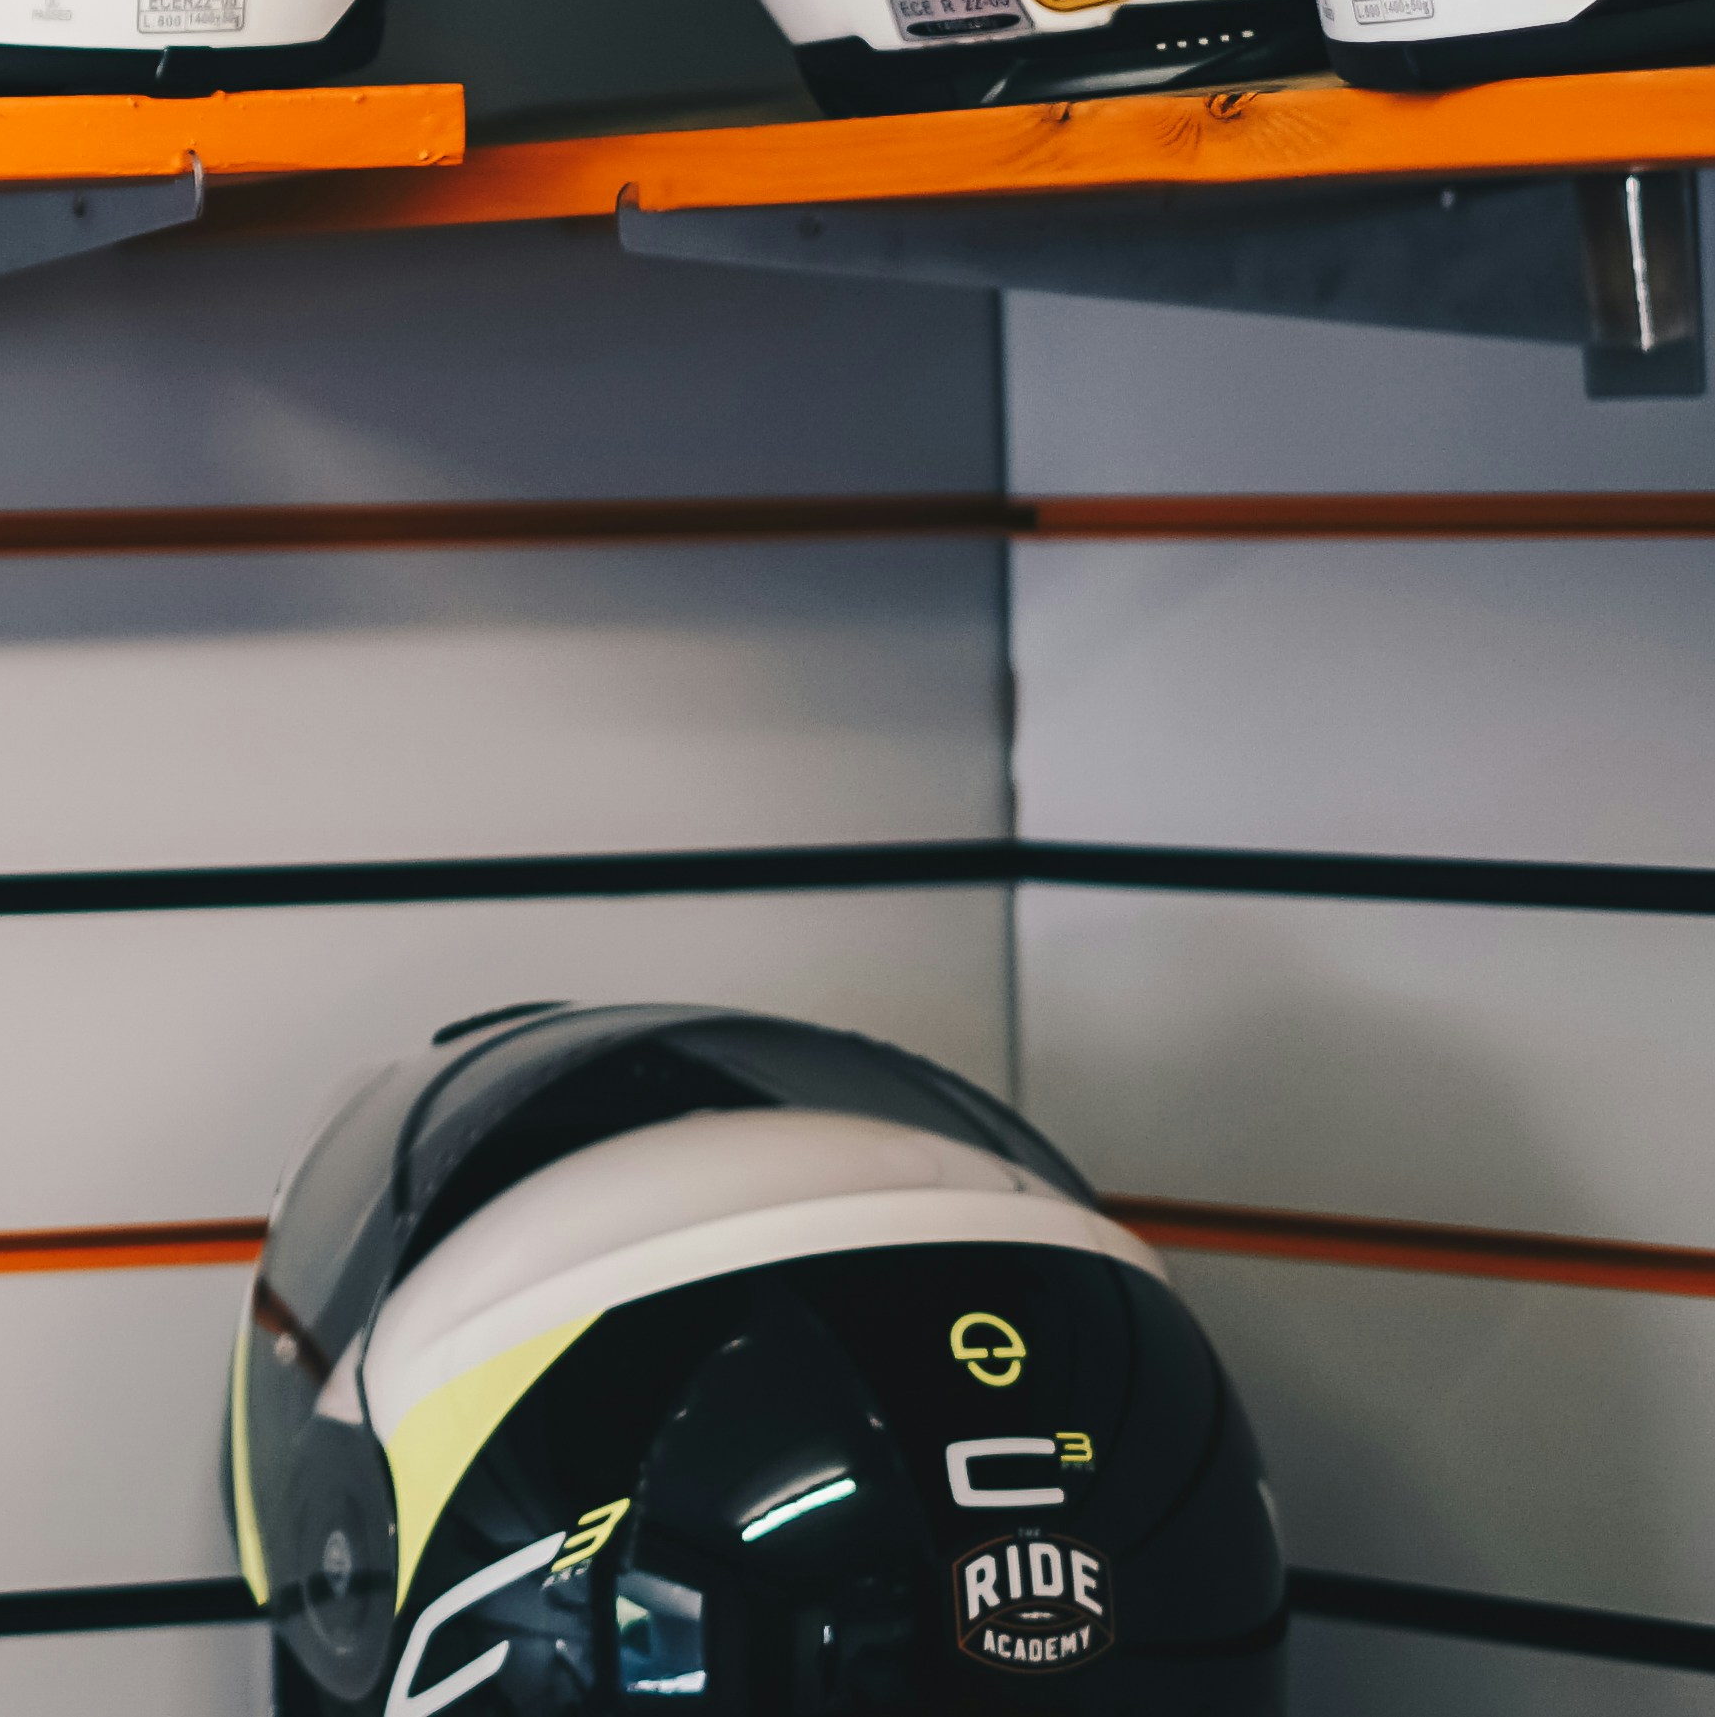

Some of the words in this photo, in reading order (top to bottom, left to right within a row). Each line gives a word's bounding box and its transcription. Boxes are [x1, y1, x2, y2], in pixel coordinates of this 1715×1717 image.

[900, 0, 933, 17] ECE
[965, 1542, 1103, 1620] RIDE
[983, 1625, 1091, 1662] ACADEMY
